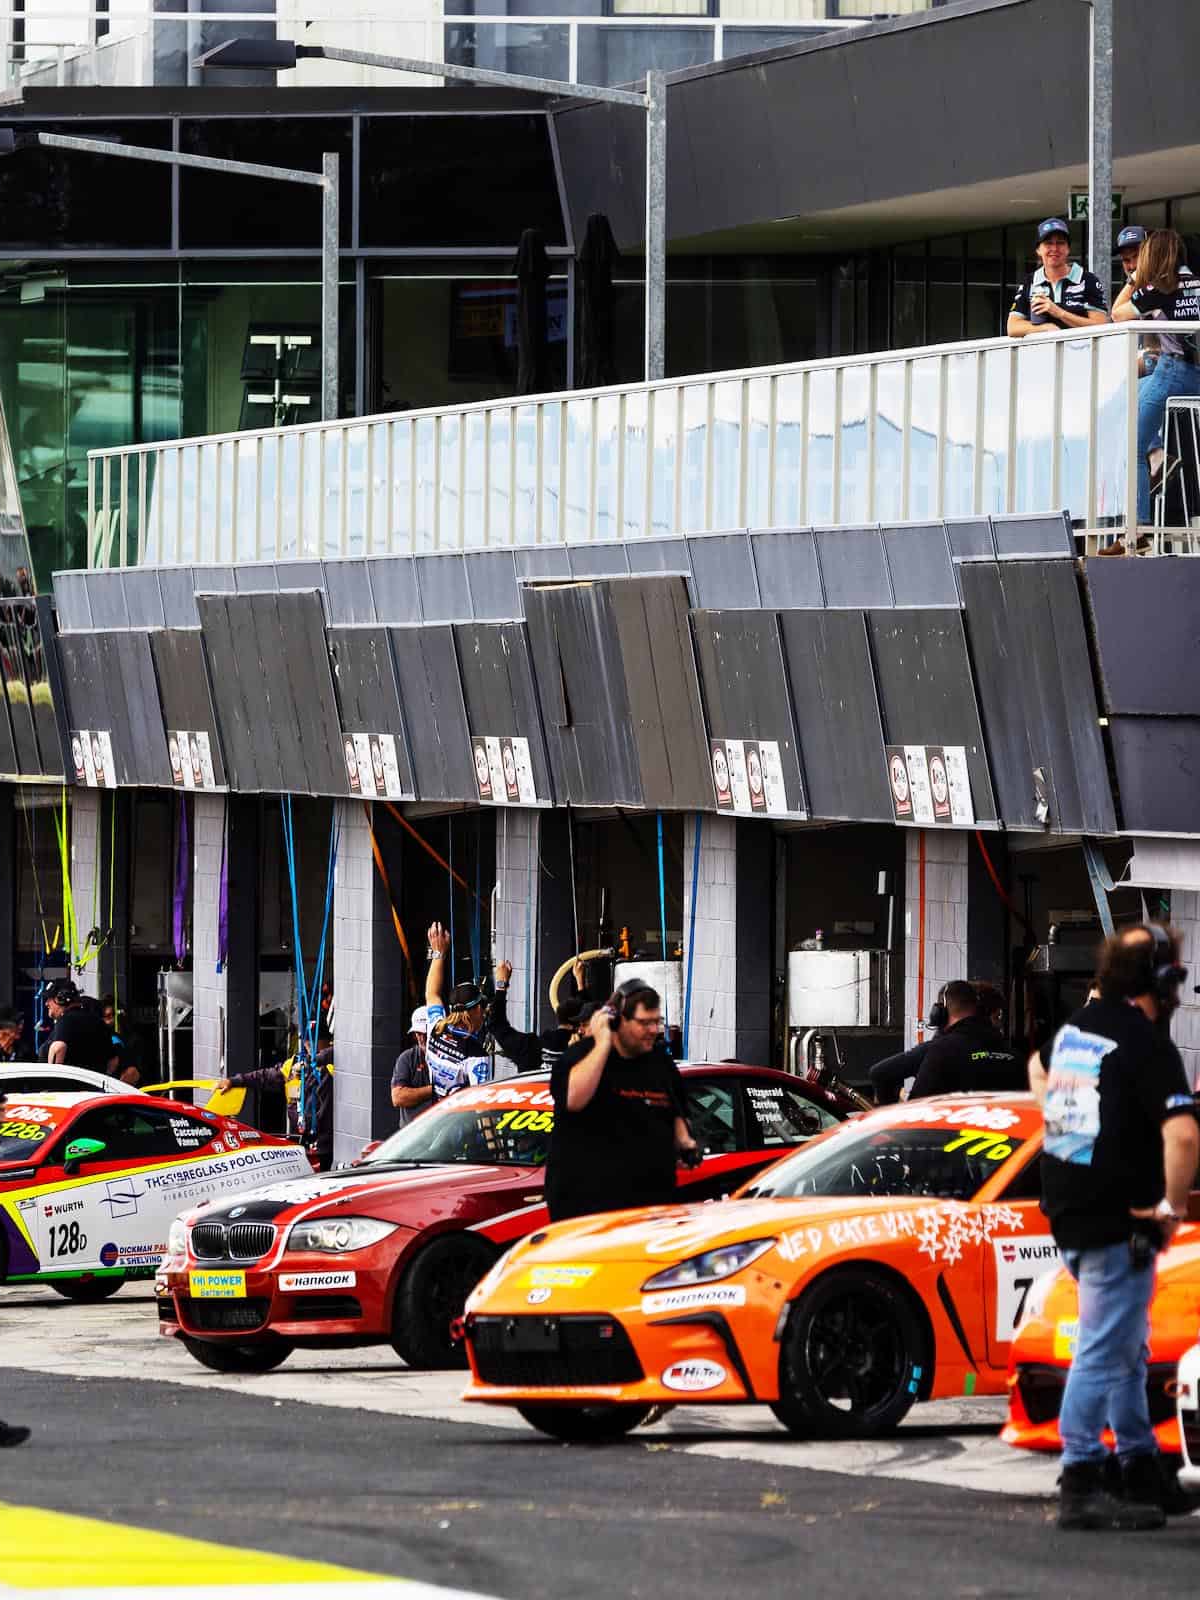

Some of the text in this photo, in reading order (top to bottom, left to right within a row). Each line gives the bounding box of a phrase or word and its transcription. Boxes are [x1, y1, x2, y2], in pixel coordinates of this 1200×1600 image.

[229, 1152, 262, 1169] POOL
[220, 1177, 247, 1188] POOL
[119, 1244, 153, 1254] DICKMAN
[127, 1255, 162, 1265] SHELVING
[208, 1275, 243, 1286] POWER
